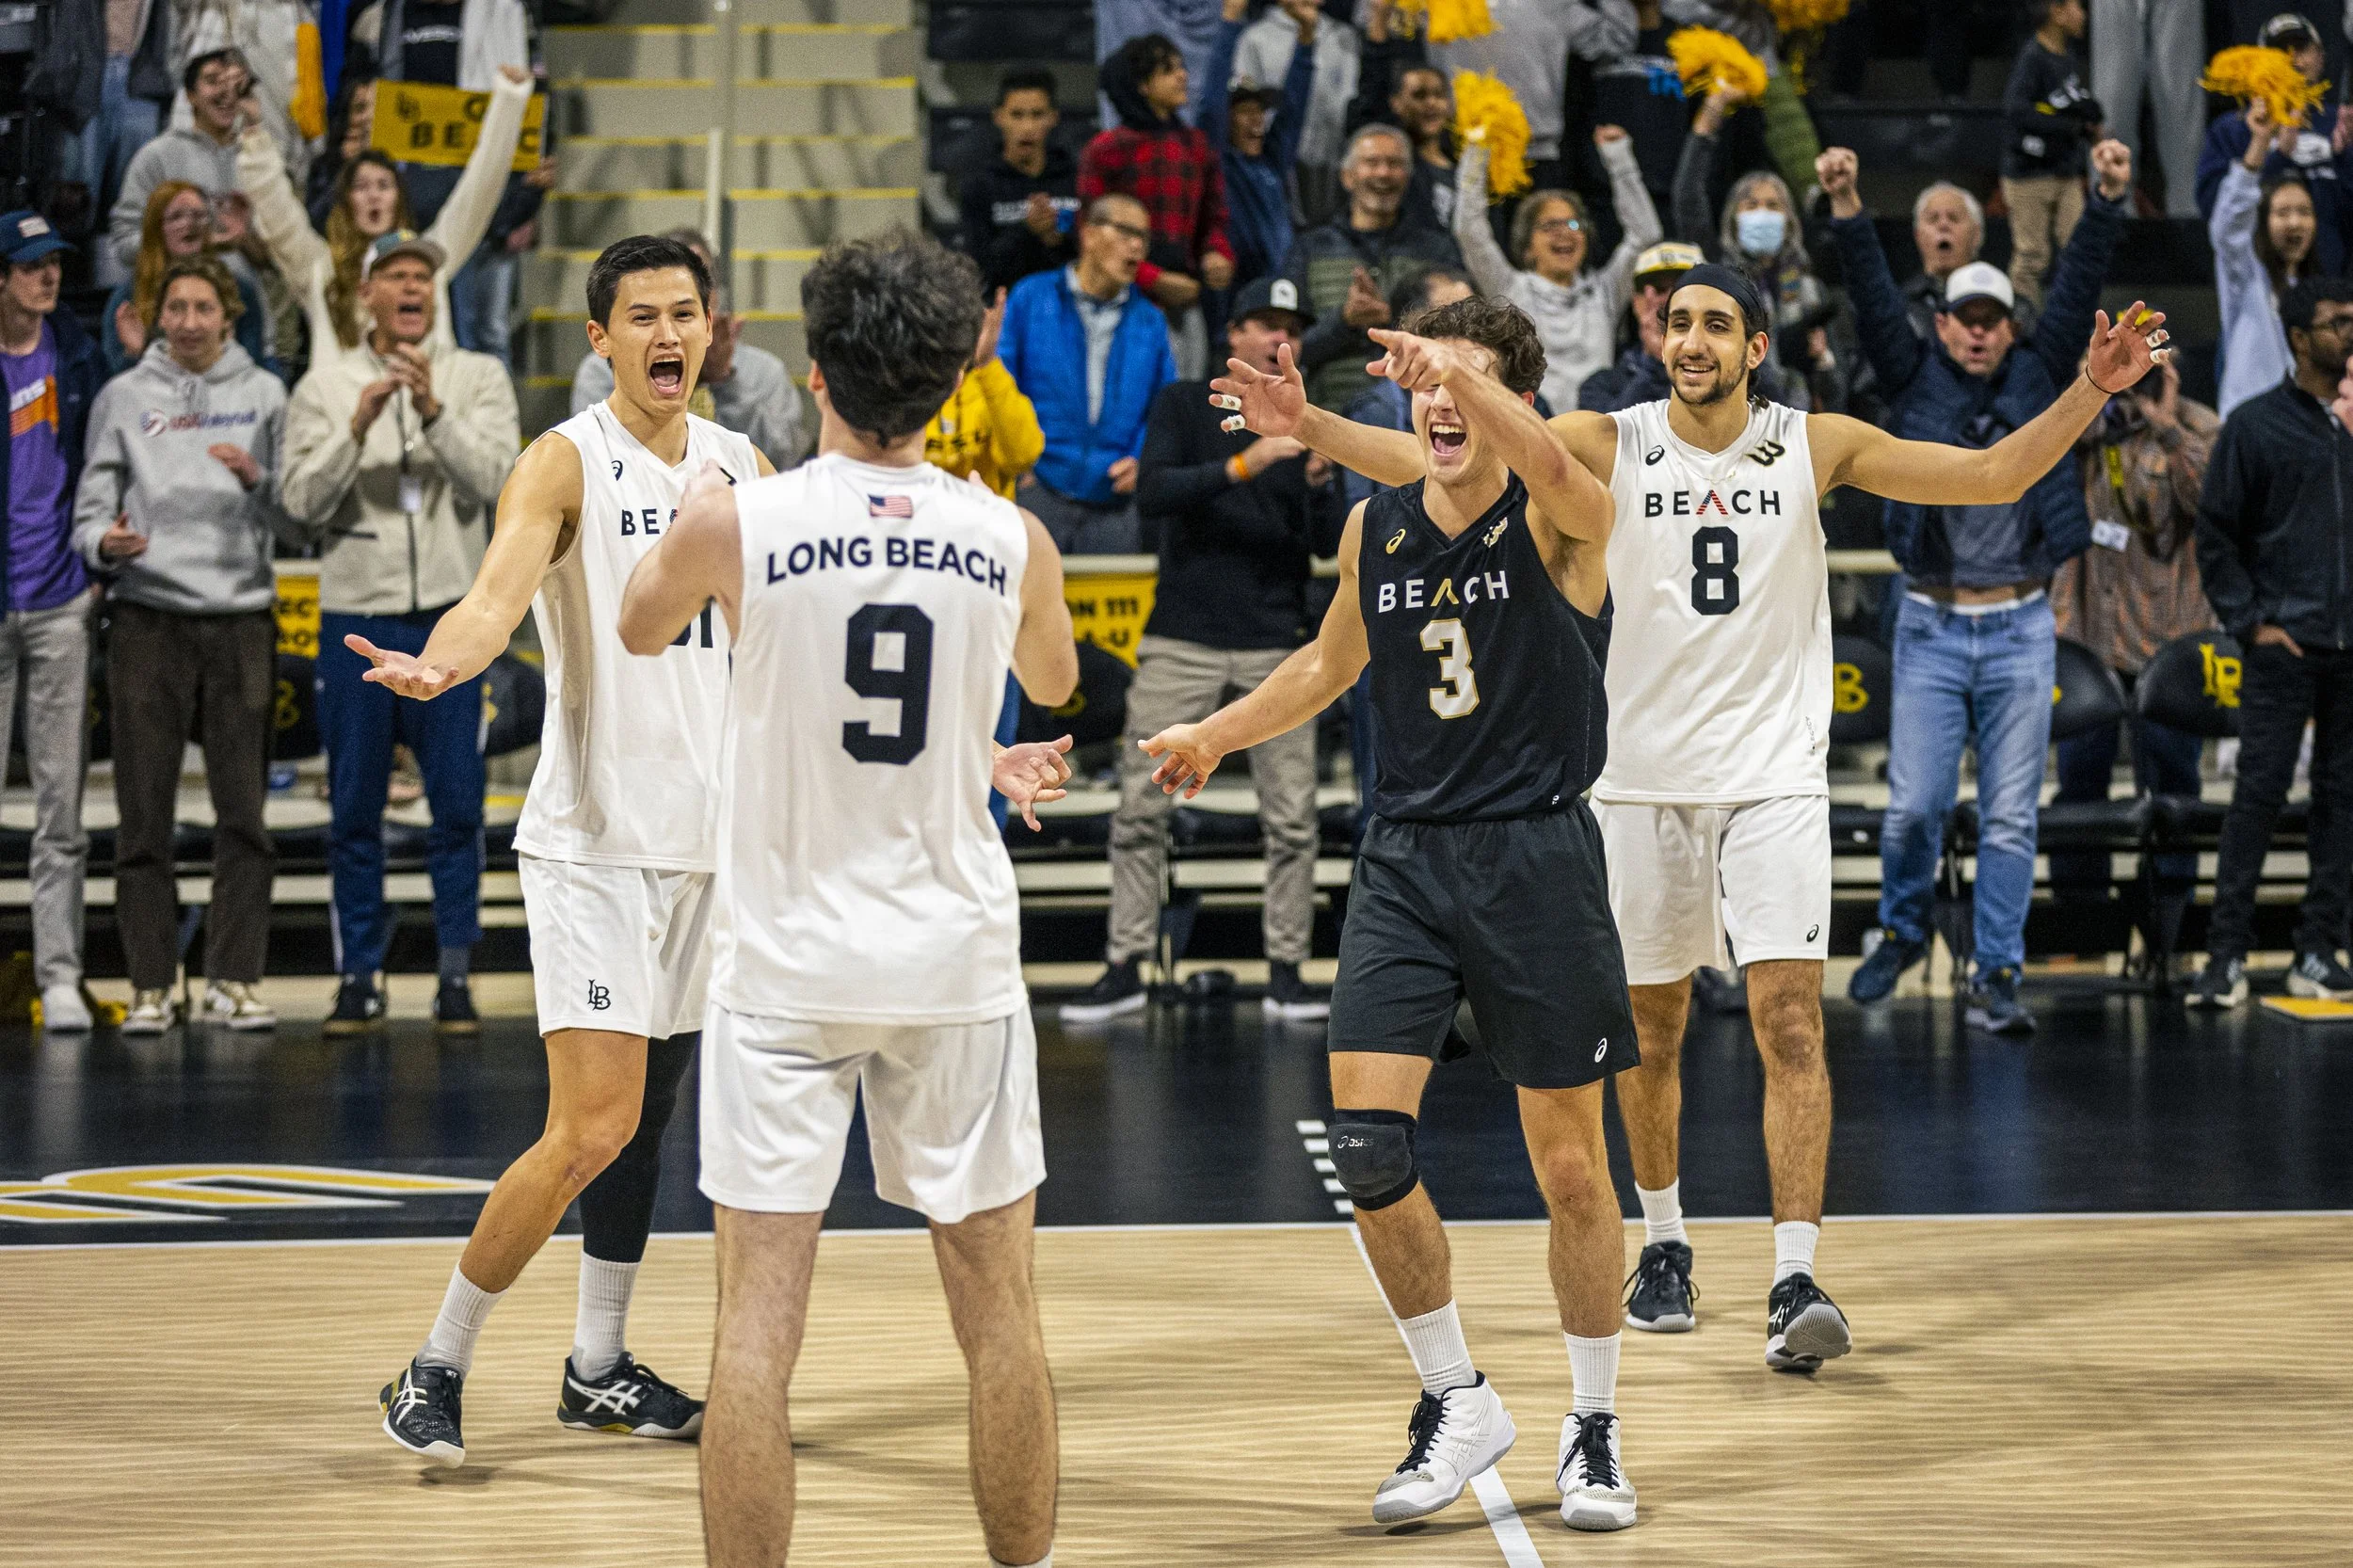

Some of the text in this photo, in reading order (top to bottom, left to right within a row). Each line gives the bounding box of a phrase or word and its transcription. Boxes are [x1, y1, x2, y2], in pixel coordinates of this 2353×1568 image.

[1645, 489, 1781, 518] BEACH
[767, 536, 1006, 596] LONG BEACH
[1379, 570, 1510, 613] BEACH
[1691, 526, 1740, 616] 8
[669, 597, 713, 648] 1
[842, 603, 935, 766] 9
[1419, 617, 1481, 719] 3
[1833, 662, 1869, 714] B
[587, 979, 612, 1011] LB
